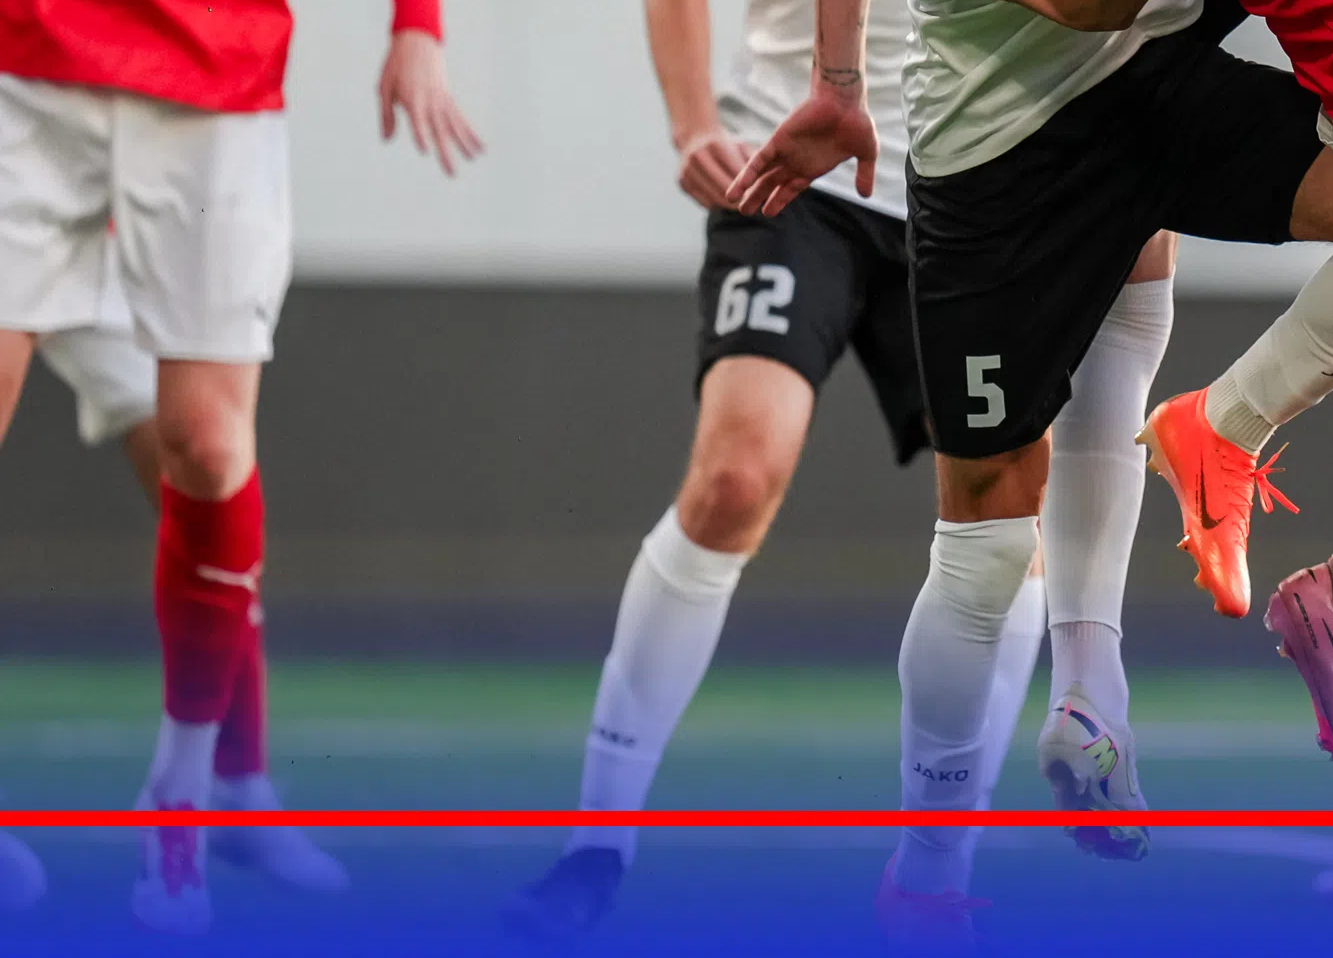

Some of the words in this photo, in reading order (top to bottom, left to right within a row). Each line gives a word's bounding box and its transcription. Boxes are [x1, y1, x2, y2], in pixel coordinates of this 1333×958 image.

[715, 264, 796, 336] 62
[965, 354, 1006, 429] 5
[913, 762, 969, 782] JAKO
